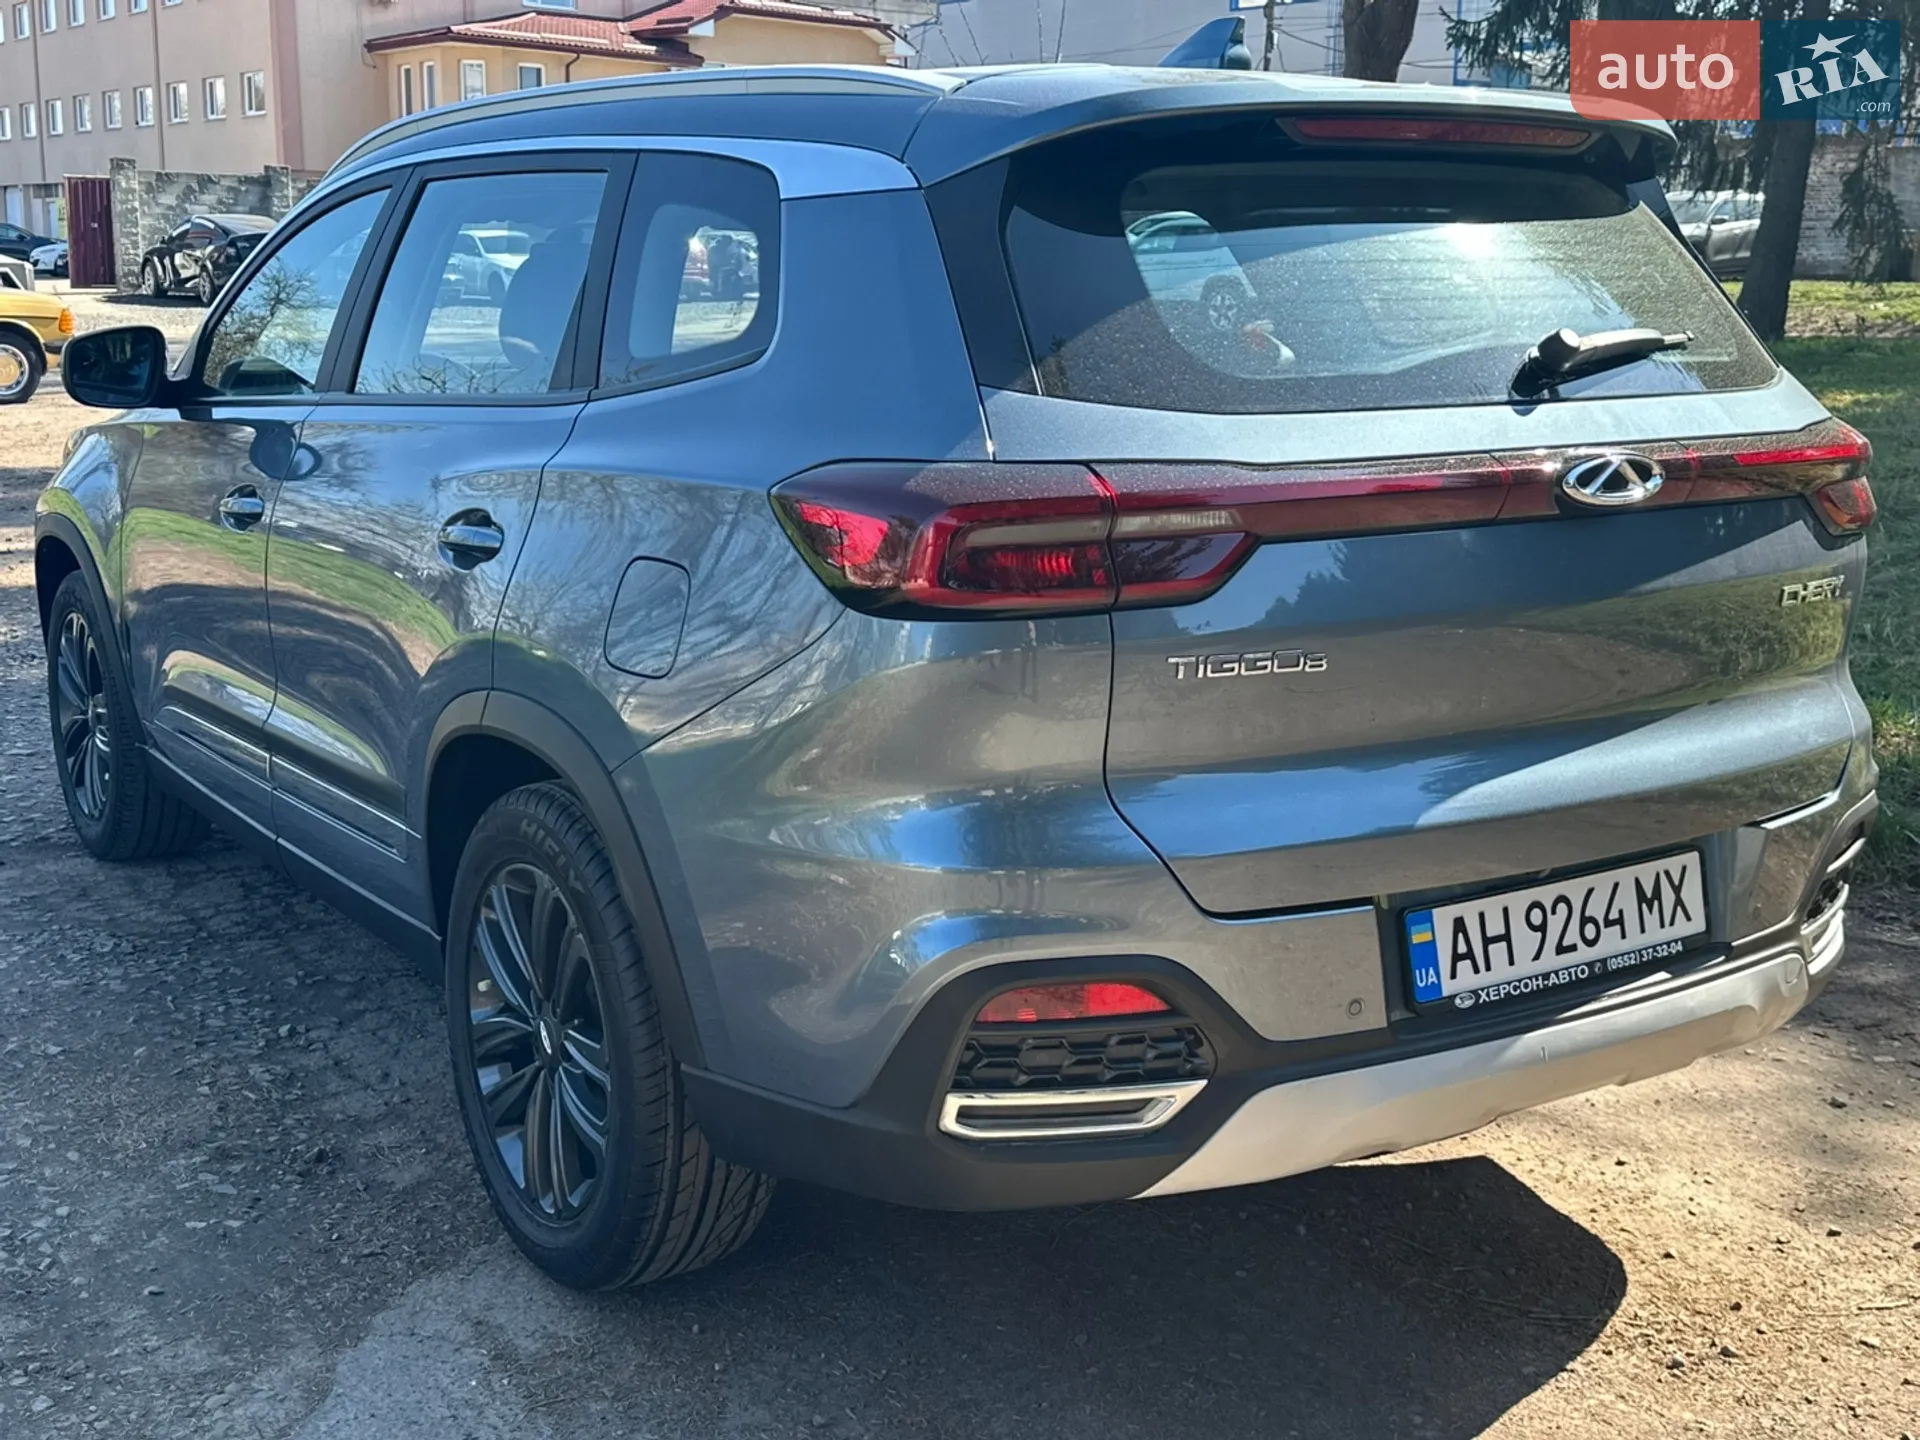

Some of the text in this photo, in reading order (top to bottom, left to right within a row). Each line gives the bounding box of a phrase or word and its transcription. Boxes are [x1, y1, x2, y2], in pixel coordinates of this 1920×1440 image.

[1781, 575, 1845, 607] CHERY
[1449, 864, 1693, 980] AH 9264 MX
[1415, 966, 1439, 988] UA
[1478, 940, 1683, 1004] ХЕРСОН-АВТО (0552) 37-32-04
